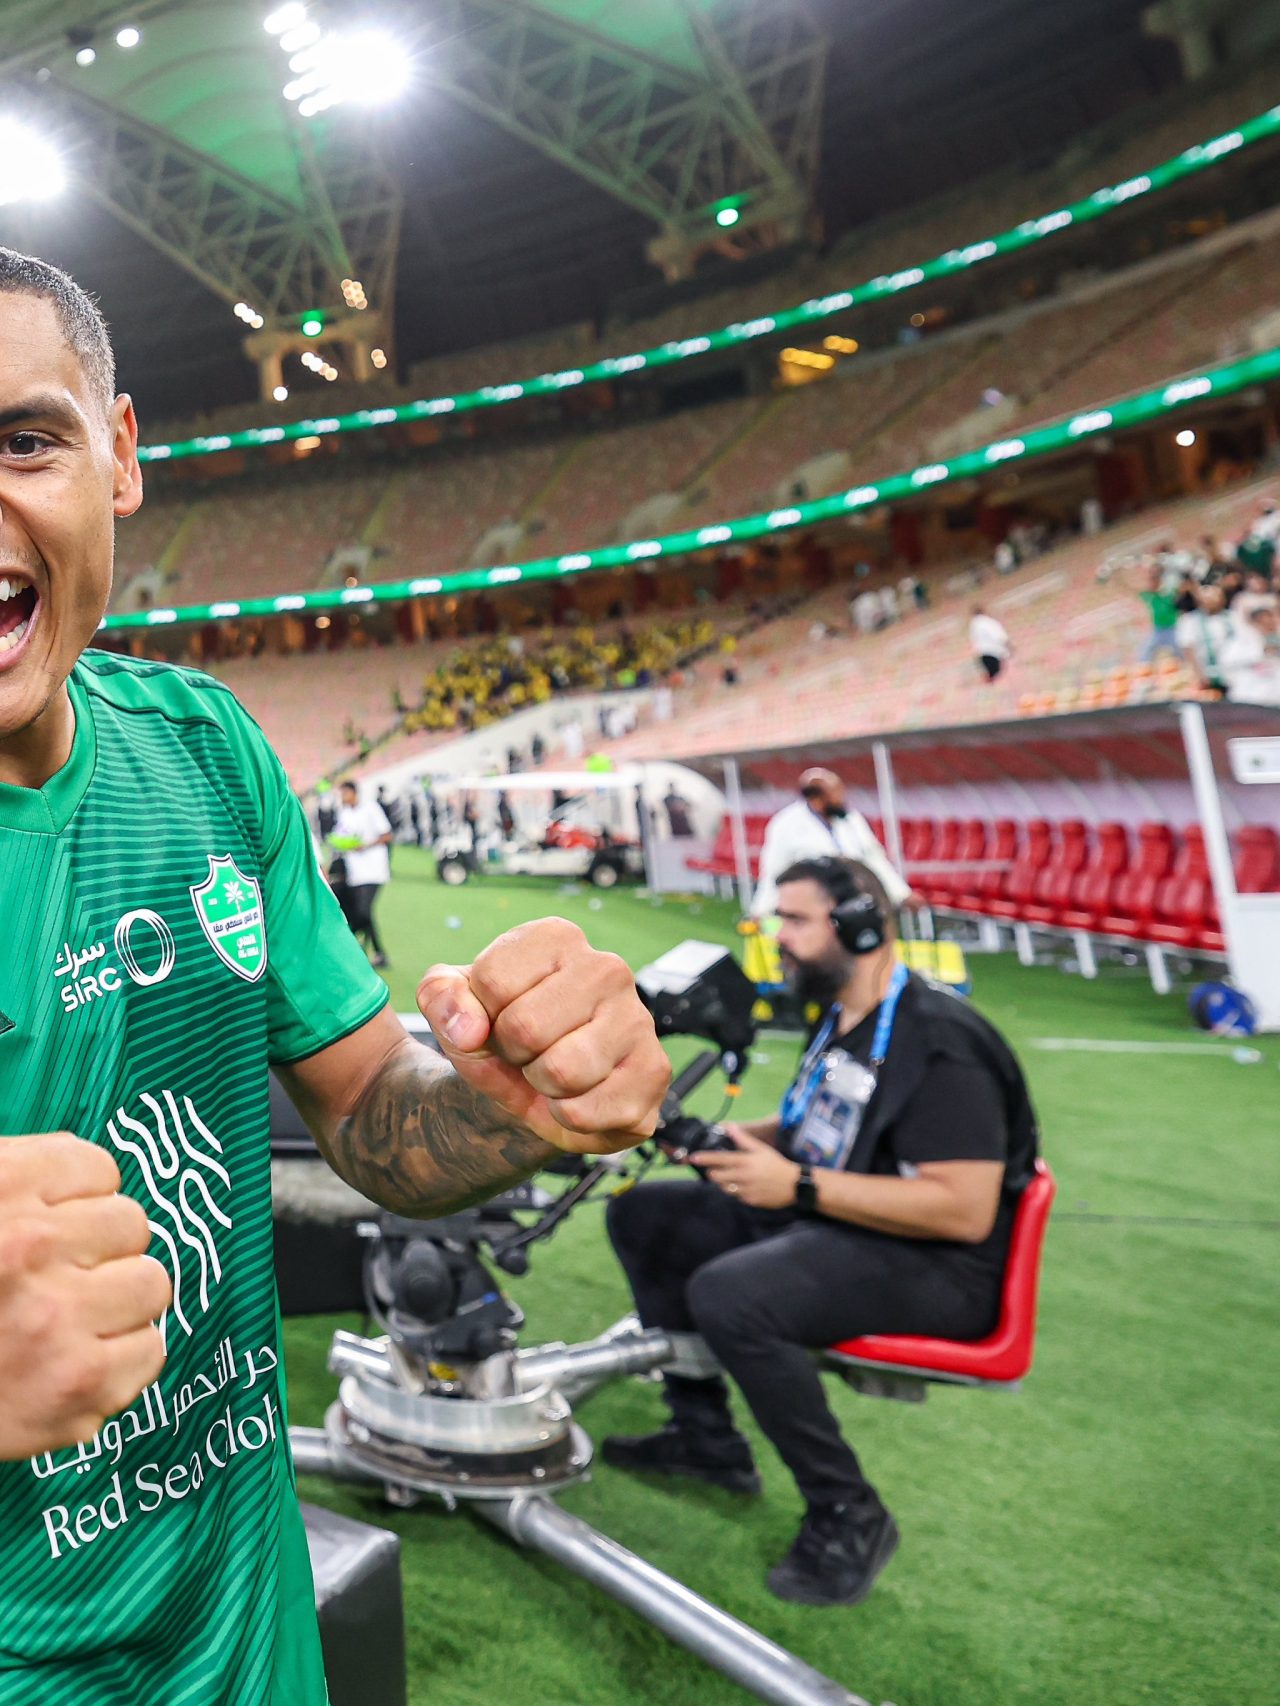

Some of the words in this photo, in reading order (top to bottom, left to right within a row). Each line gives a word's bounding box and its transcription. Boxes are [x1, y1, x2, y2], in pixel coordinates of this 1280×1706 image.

[54, 941, 106, 980] سرك
[60, 967, 122, 1013] SIRC
[173, 1336, 239, 1437] الأحمر
[42, 1471, 129, 1559] Red
[135, 1450, 205, 1512] Sea
